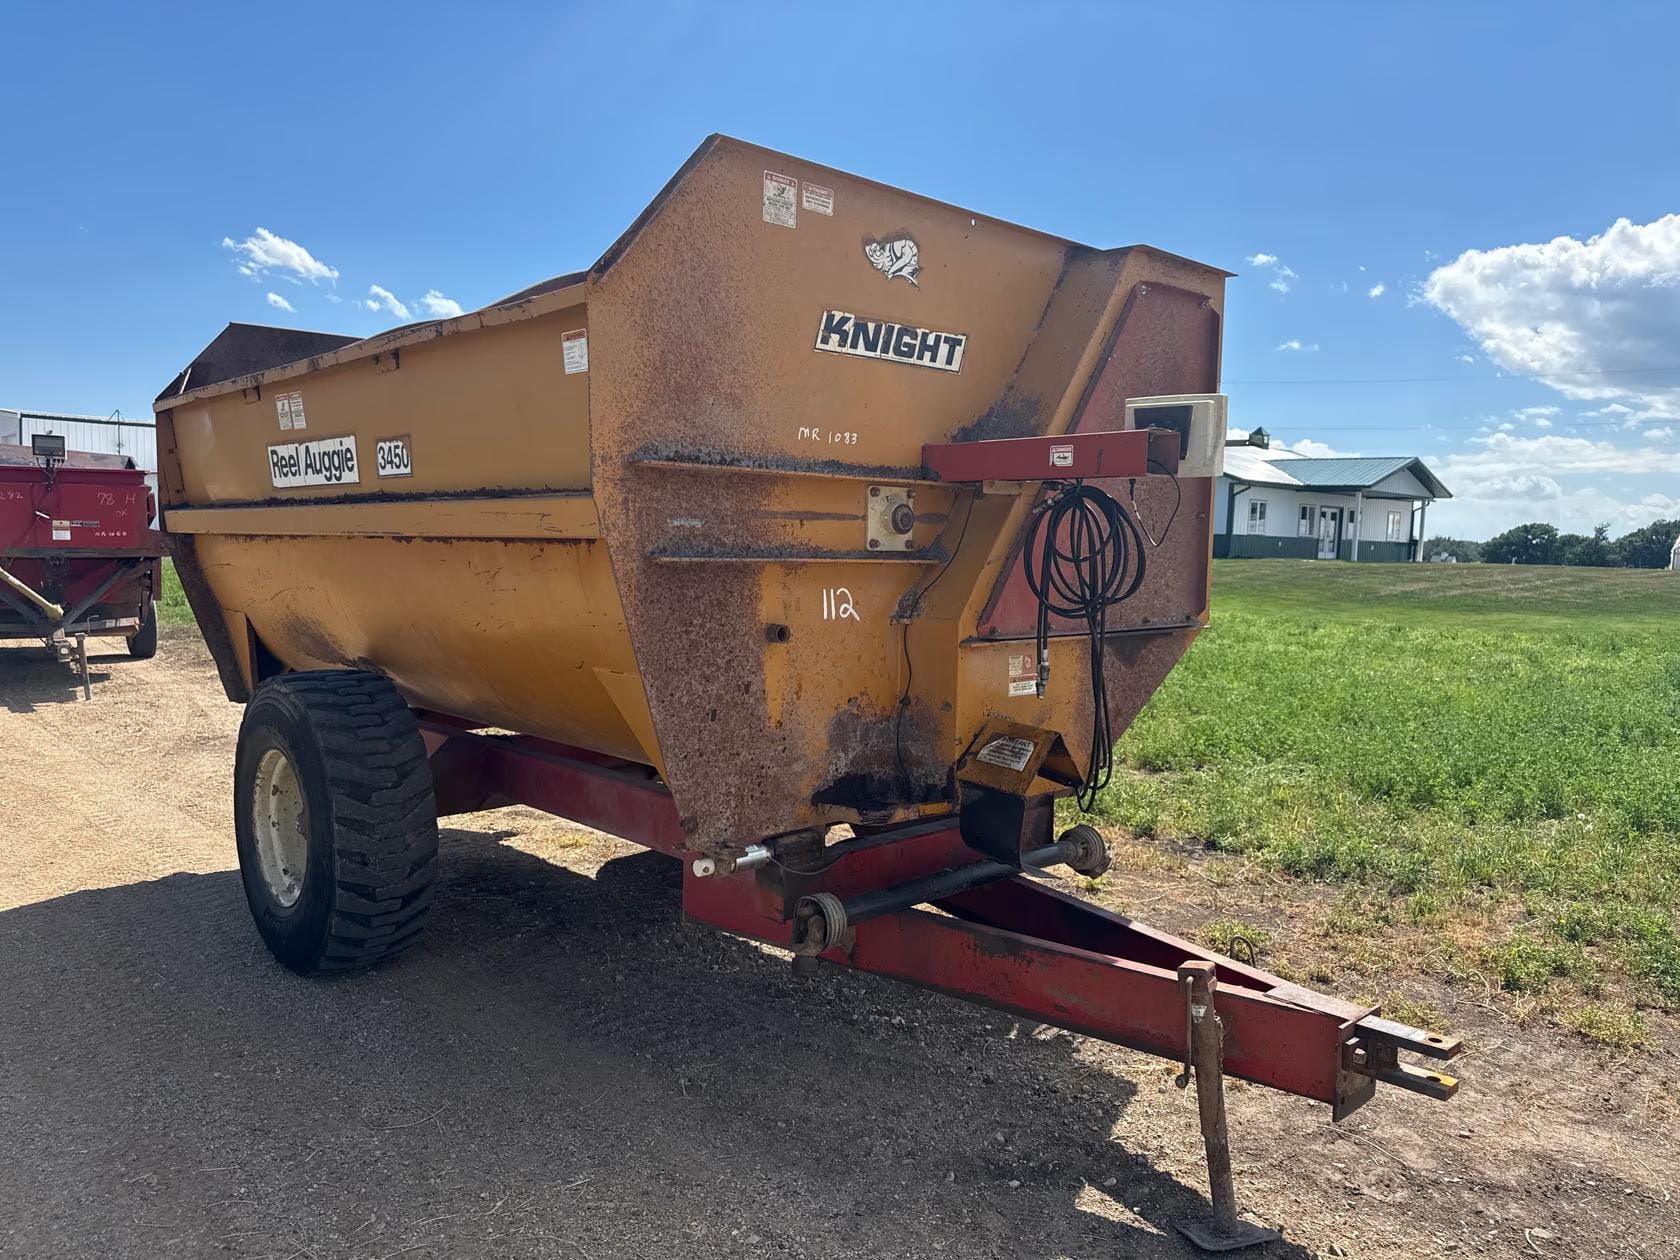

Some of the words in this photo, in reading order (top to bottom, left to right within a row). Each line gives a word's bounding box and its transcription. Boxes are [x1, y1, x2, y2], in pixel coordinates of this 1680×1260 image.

[820, 312, 963, 366] KNIGHT
[798, 426, 820, 440] MR
[828, 431, 858, 445] 1083
[270, 446, 302, 479] Reel
[304, 440, 355, 482] Auggie
[378, 444, 410, 470] 3450
[823, 587, 861, 621] 112
